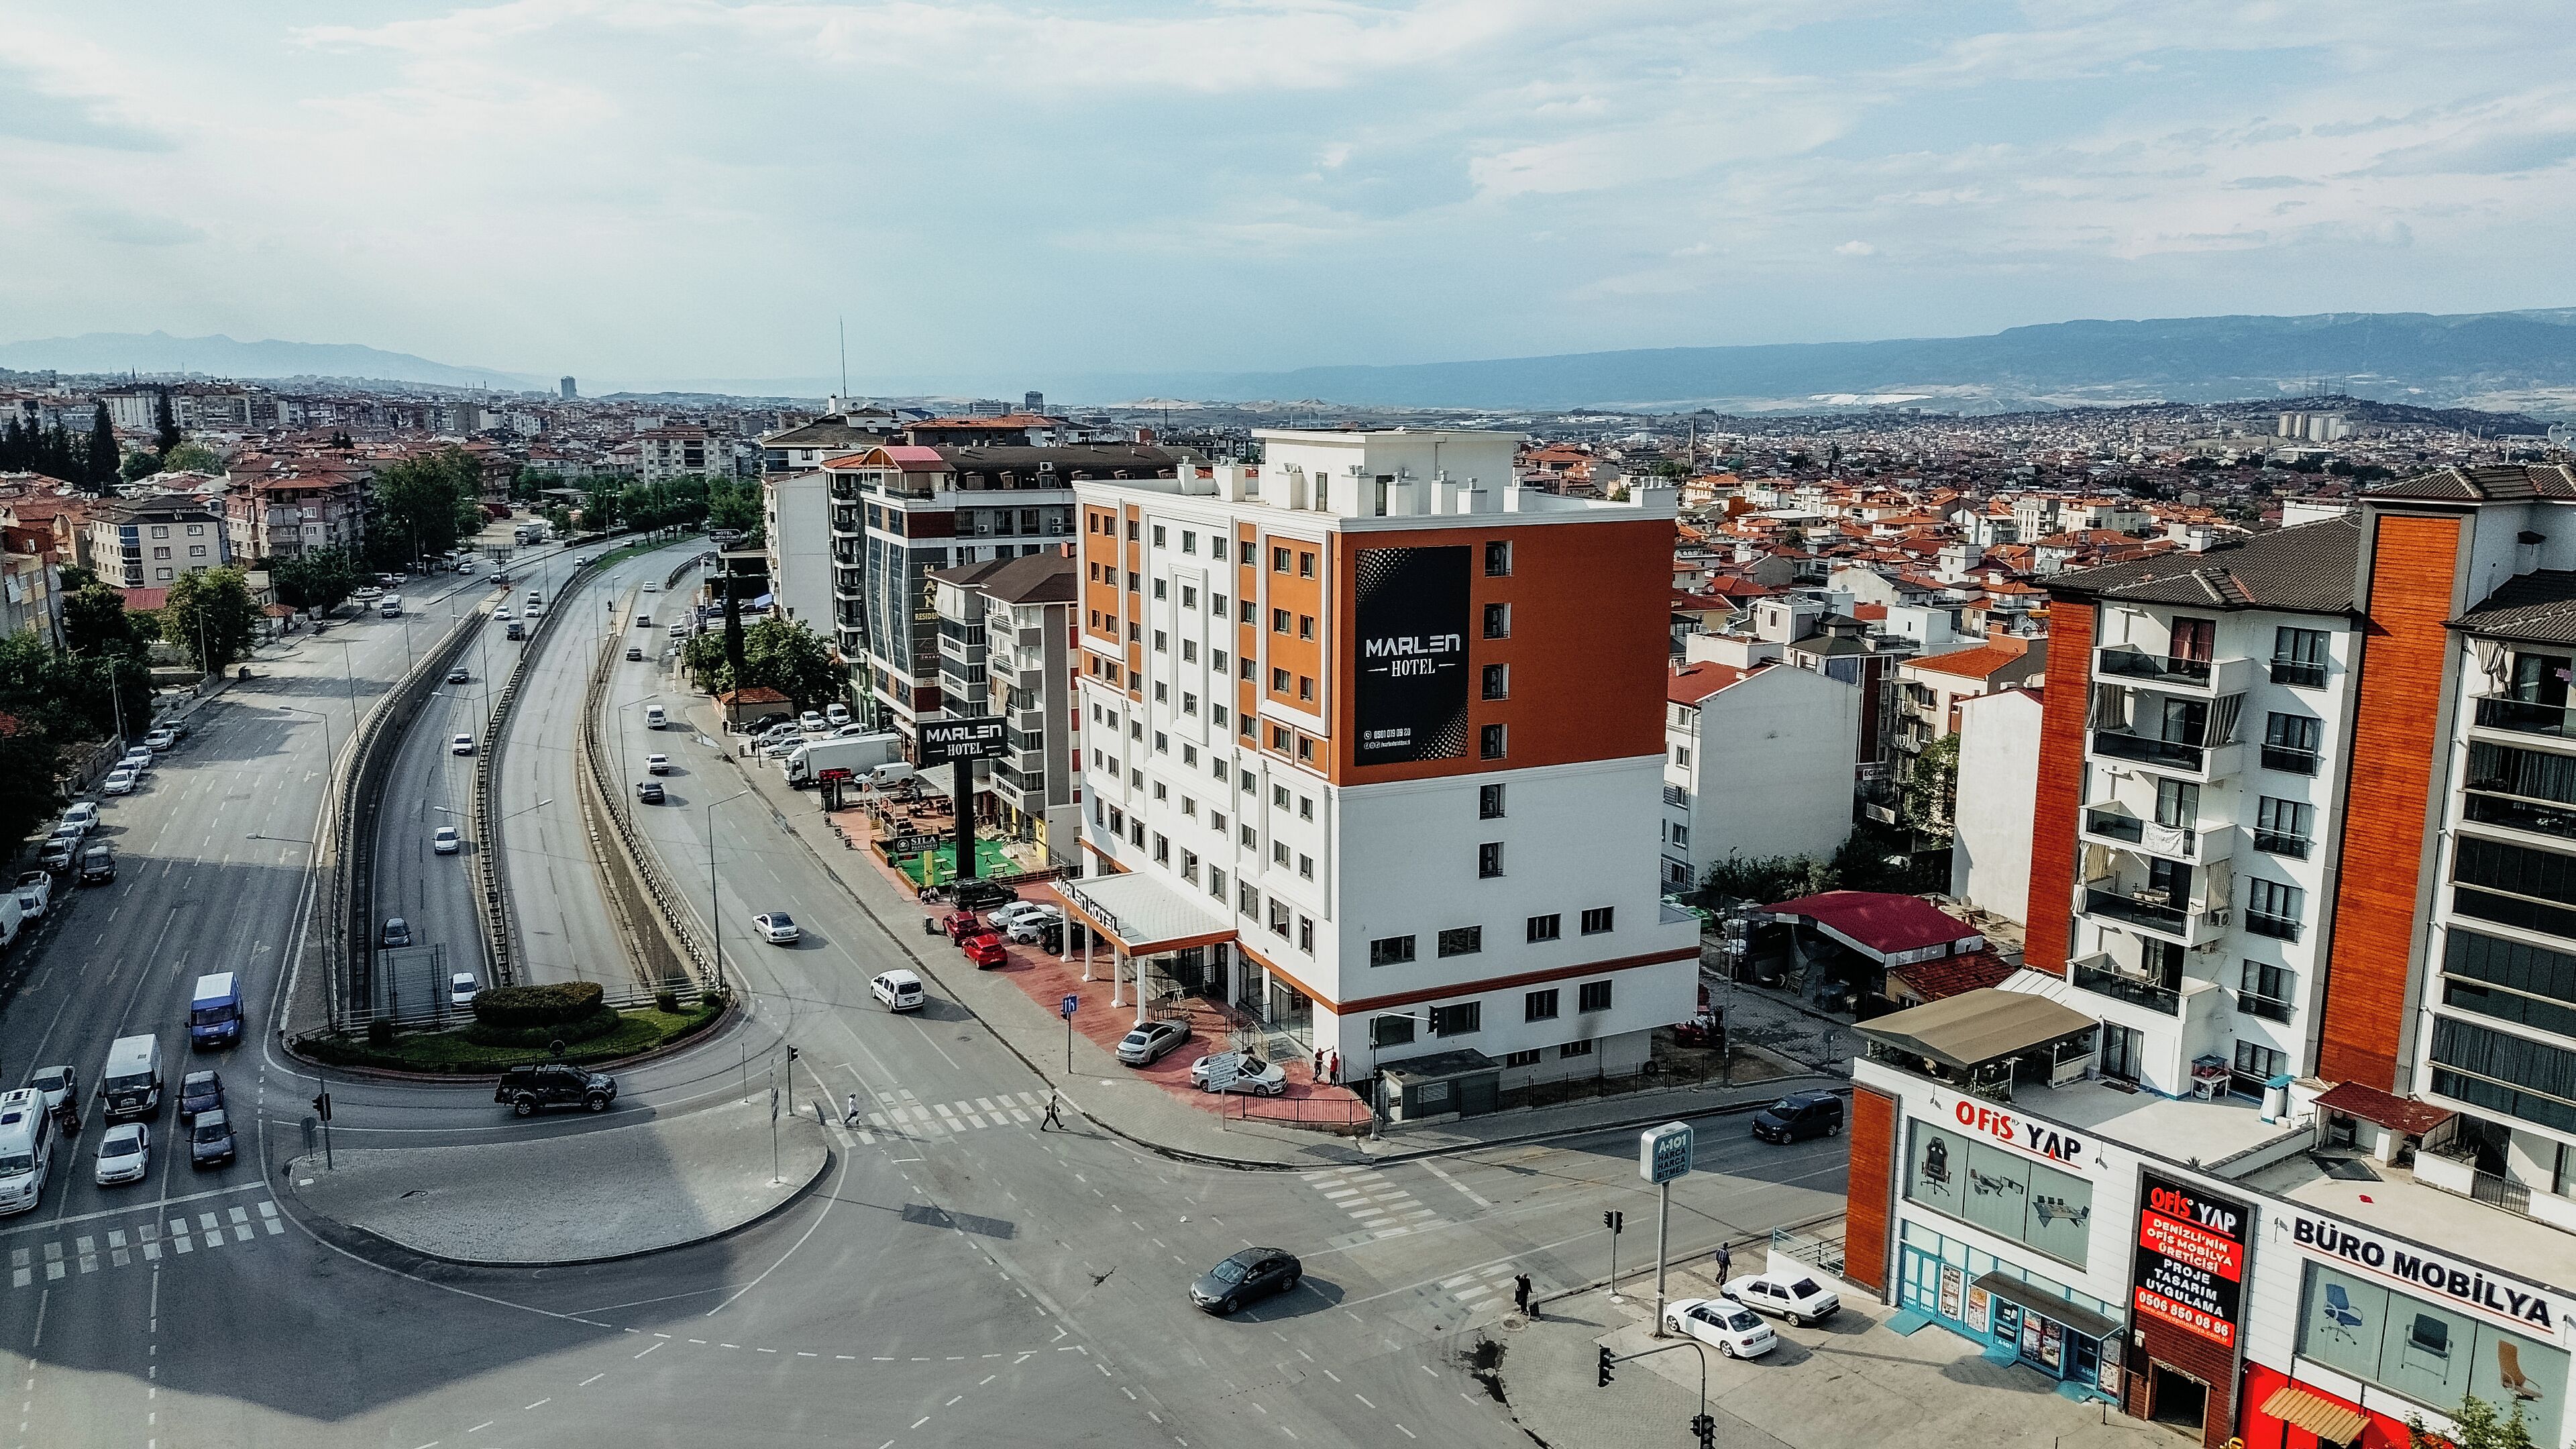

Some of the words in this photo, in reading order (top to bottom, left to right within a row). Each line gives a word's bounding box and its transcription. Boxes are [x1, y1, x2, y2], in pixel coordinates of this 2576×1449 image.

[914, 612, 939, 621] RESIDEN
[1366, 634, 1460, 657] MARLEN
[1391, 658, 1436, 677] HOTEL
[926, 724, 1002, 743] MARLEN
[1403, 727, 1411, 736] 20
[947, 742, 983, 756] HOTEL
[911, 836, 936, 845] SILA
[1088, 900, 1120, 936] HOTEL
[2025, 1122, 2082, 1162] YAP
[1657, 1156, 1686, 1171] HARCA
[1658, 1147, 1686, 1163] HARCA
[2198, 1203, 2237, 1232] YAP
[2163, 1258, 2211, 1285] PROJE
[2294, 1217, 2385, 1268] BÜRO
[2392, 1250, 2552, 1329] MOBİLYA
[2154, 1268, 2218, 1301] TASARIM
[2146, 1278, 2224, 1318] UYGULAMA
[2139, 1291, 2168, 1311] 0506
[2170, 1303, 2193, 1322] 850
[2195, 1313, 2210, 1330] 08
[2214, 1321, 2229, 1337] 86
